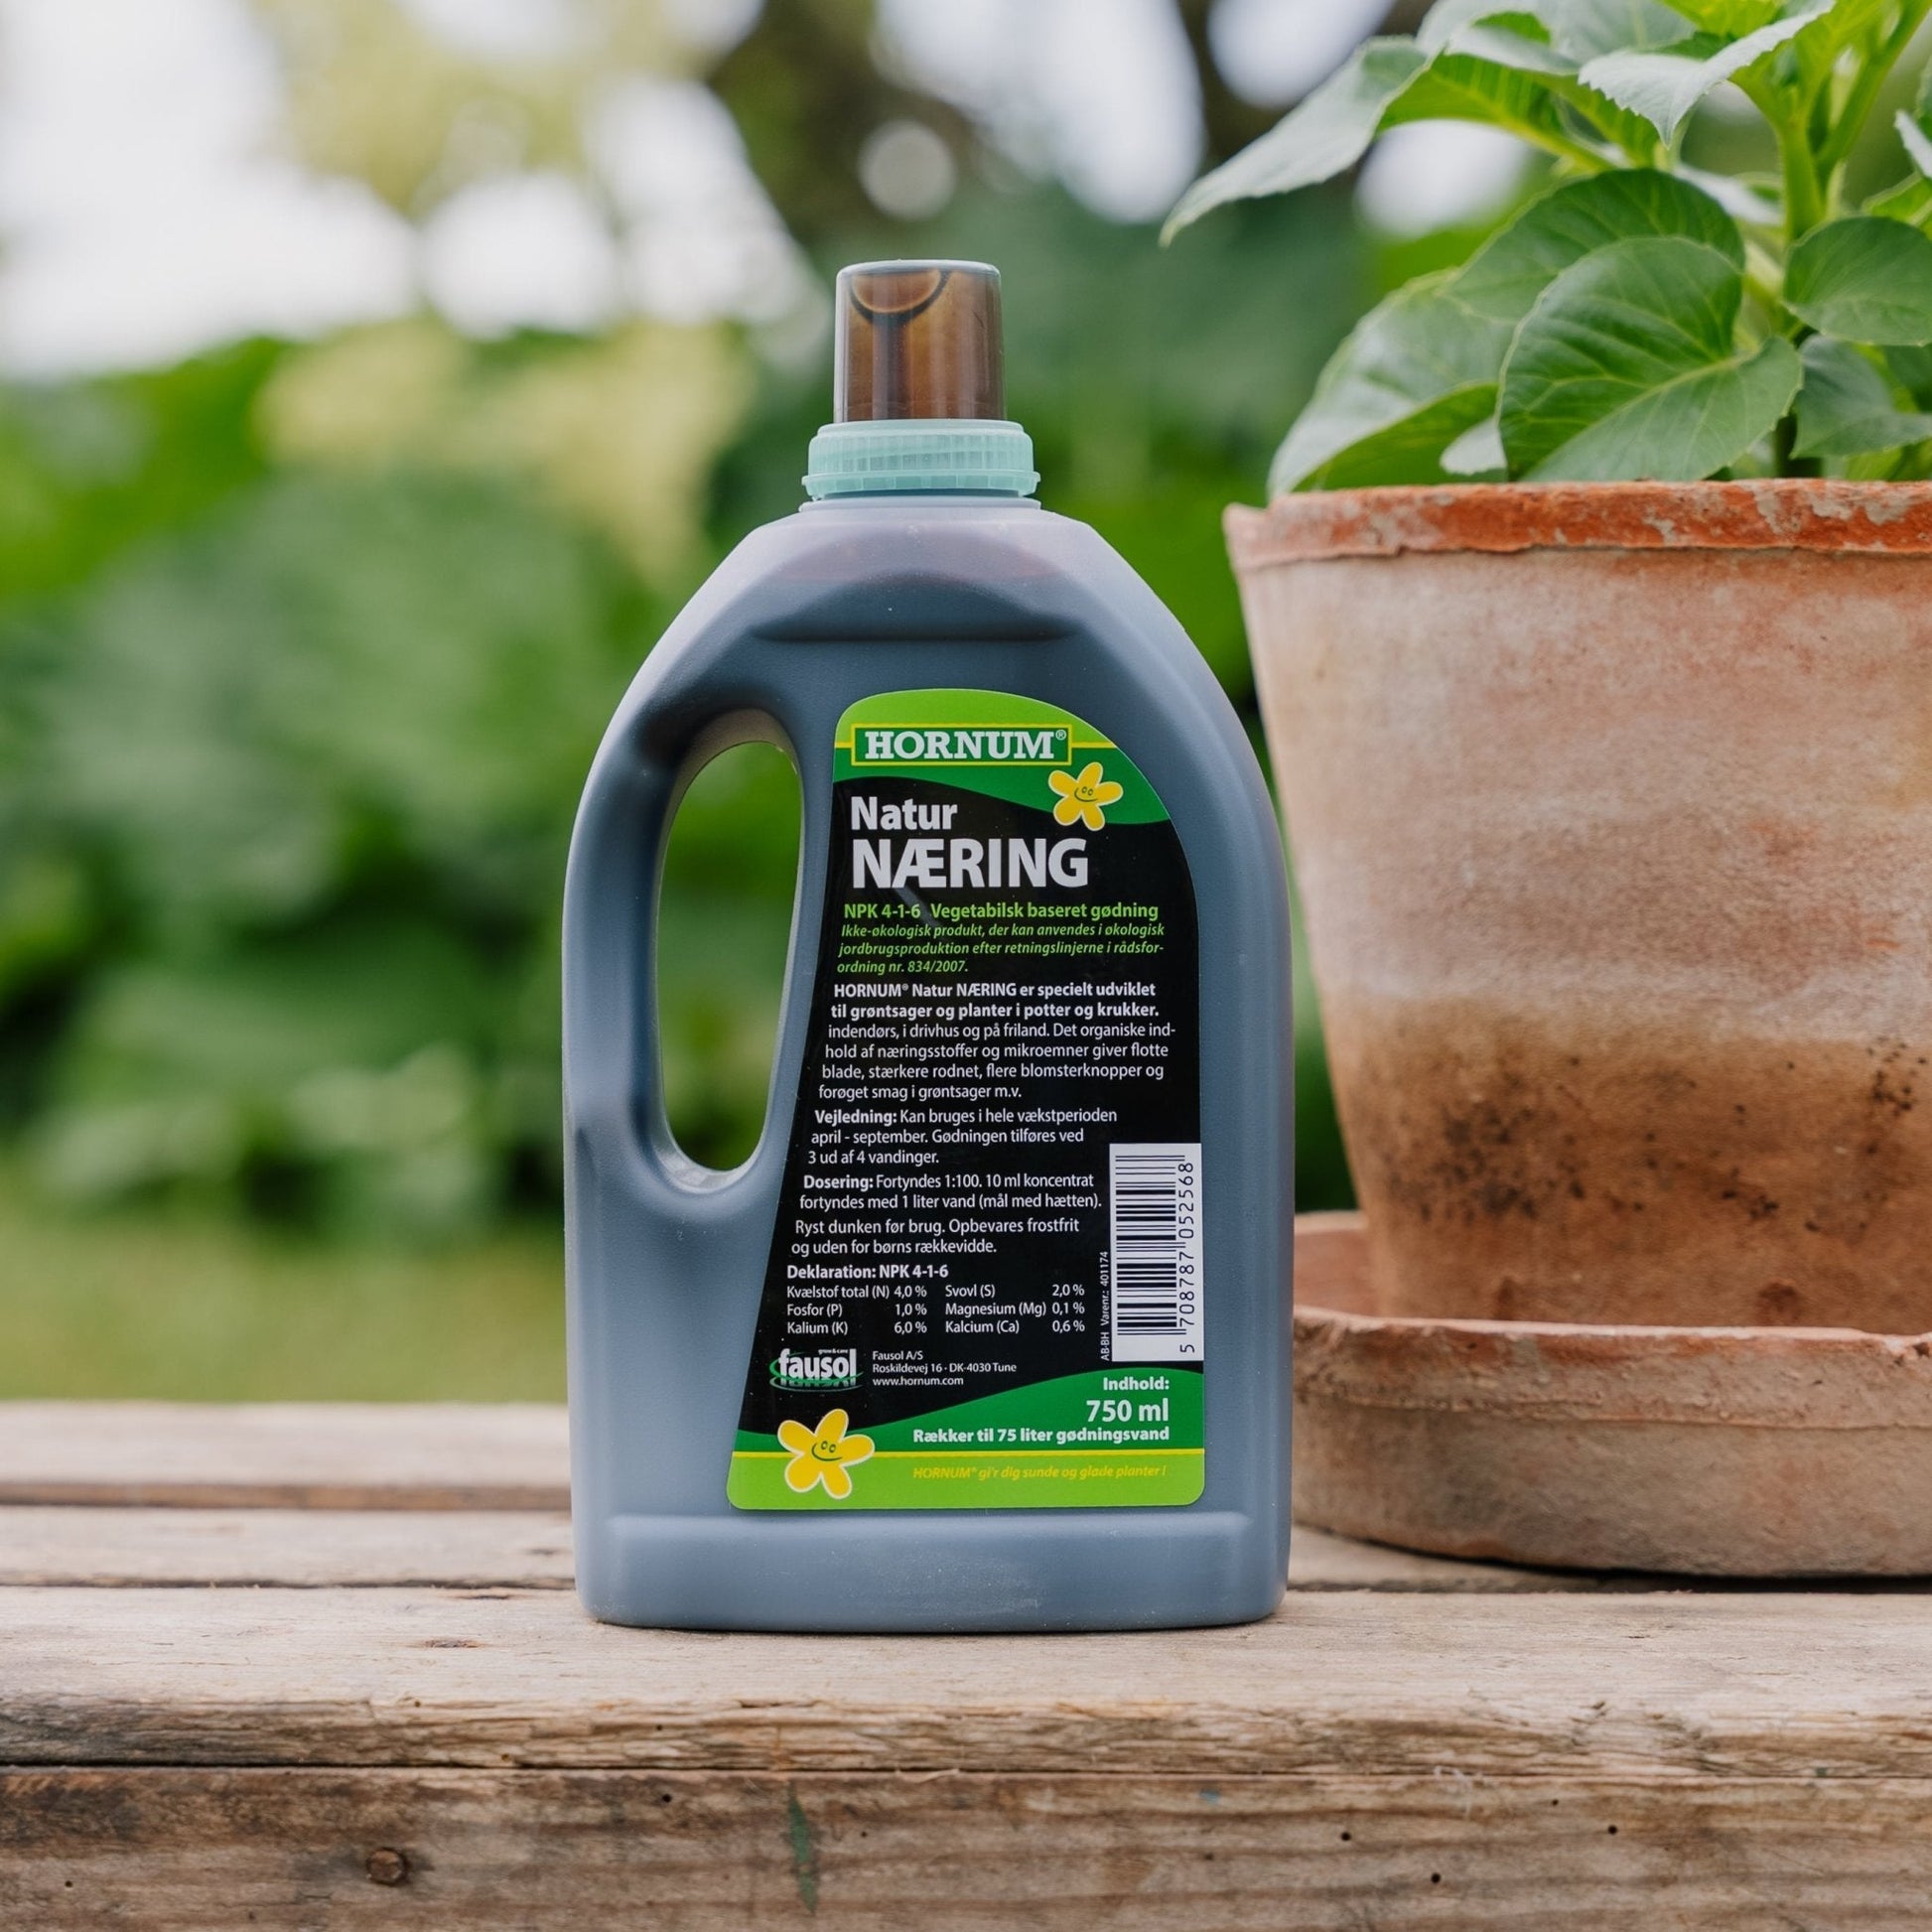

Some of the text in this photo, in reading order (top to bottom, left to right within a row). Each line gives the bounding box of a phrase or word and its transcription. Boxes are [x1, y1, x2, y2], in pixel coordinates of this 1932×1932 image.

[851, 796, 958, 830] Natur
[853, 838, 1088, 889] NÆRING
[844, 902, 1159, 922] NPK 4-1-6 Vegetabilsk baseret gødning
[841, 922, 1165, 939] Ikke-økologisk produkt, der kan anvendes i økologisk
[838, 940, 1164, 958] jordbrugsproduktion efter retningslinjerne i rådsfor-
[837, 960, 968, 976] ordning nr. 834/2007.
[912, 983, 953, 997] Natur
[956, 983, 1017, 997] NÆRING
[1020, 986, 1035, 997] er
[1037, 982, 1093, 1000] specielt
[1096, 982, 1156, 996] udviklet
[831, 1002, 1159, 1021] til grøntsager og planter i potter og krukker.
[829, 1022, 1175, 1040] indendørs, i drivhus og på friland. Det organiske ind-
[825, 1041, 1169, 1060] hold af næringsstoffer og mikroemner giver flotte
[822, 1062, 1164, 1080] blade, stærkere rodnet, flere blomsterknopper og
[818, 1084, 1022, 1102] forøget smag i grøntsager m.v.
[814, 1107, 1117, 1127] Vejledning: Kan bruges i hele vækstperioden
[811, 1128, 1084, 1147] april september. Gødningen tilføres ved
[808, 1149, 939, 1167] 3 ud af 4 vandinger.
[804, 1173, 1094, 1192] Dosering: Fortyndes 1:100. 10 ml koncentrat
[799, 1193, 1102, 1212] fortyndes med 1 liter vand (mål med hætten).
[1177, 1163, 1194, 1239] 052568
[795, 1217, 1079, 1237] Ryst dunken før brug. Opbevares frostfrit
[791, 1238, 997, 1257] og uden for børns rækkevidde.
[787, 1264, 949, 1279] Deklaration: NPK 4-1-6
[1099, 1251, 1109, 1287] 401174
[787, 1285, 890, 1300] Kvælstof total (N)
[894, 1285, 912, 1299] 4,0
[945, 1284, 996, 1299] Svovl (S)
[1052, 1284, 1070, 1298] 2,0
[1178, 1251, 1195, 1327] 708787
[787, 1303, 843, 1317] Fosfor (P)
[896, 1304, 912, 1317] 1,0
[945, 1302, 1046, 1318] Magnesium (Mg)
[1051, 1302, 1068, 1315] 0,1
[1100, 1291, 1110, 1325] Varenr.:
[787, 1321, 848, 1335] Kalium (K)
[894, 1321, 912, 1335] 6,0
[945, 1319, 1020, 1334] Kalcium (Ca)
[1052, 1319, 1071, 1333] 0,6
[778, 1348, 857, 1379] fausol
[873, 1350, 923, 1360] Fausol A/S
[873, 1362, 1018, 1375] Roskildevej 16 DK-4030 Tune
[873, 1376, 964, 1386] www.hornum.com
[1103, 1376, 1170, 1391] Indhold:
[1086, 1398, 1169, 1422] 750 ml
[913, 1426, 1170, 1445] Rækker til 75 liter gødningsvand
